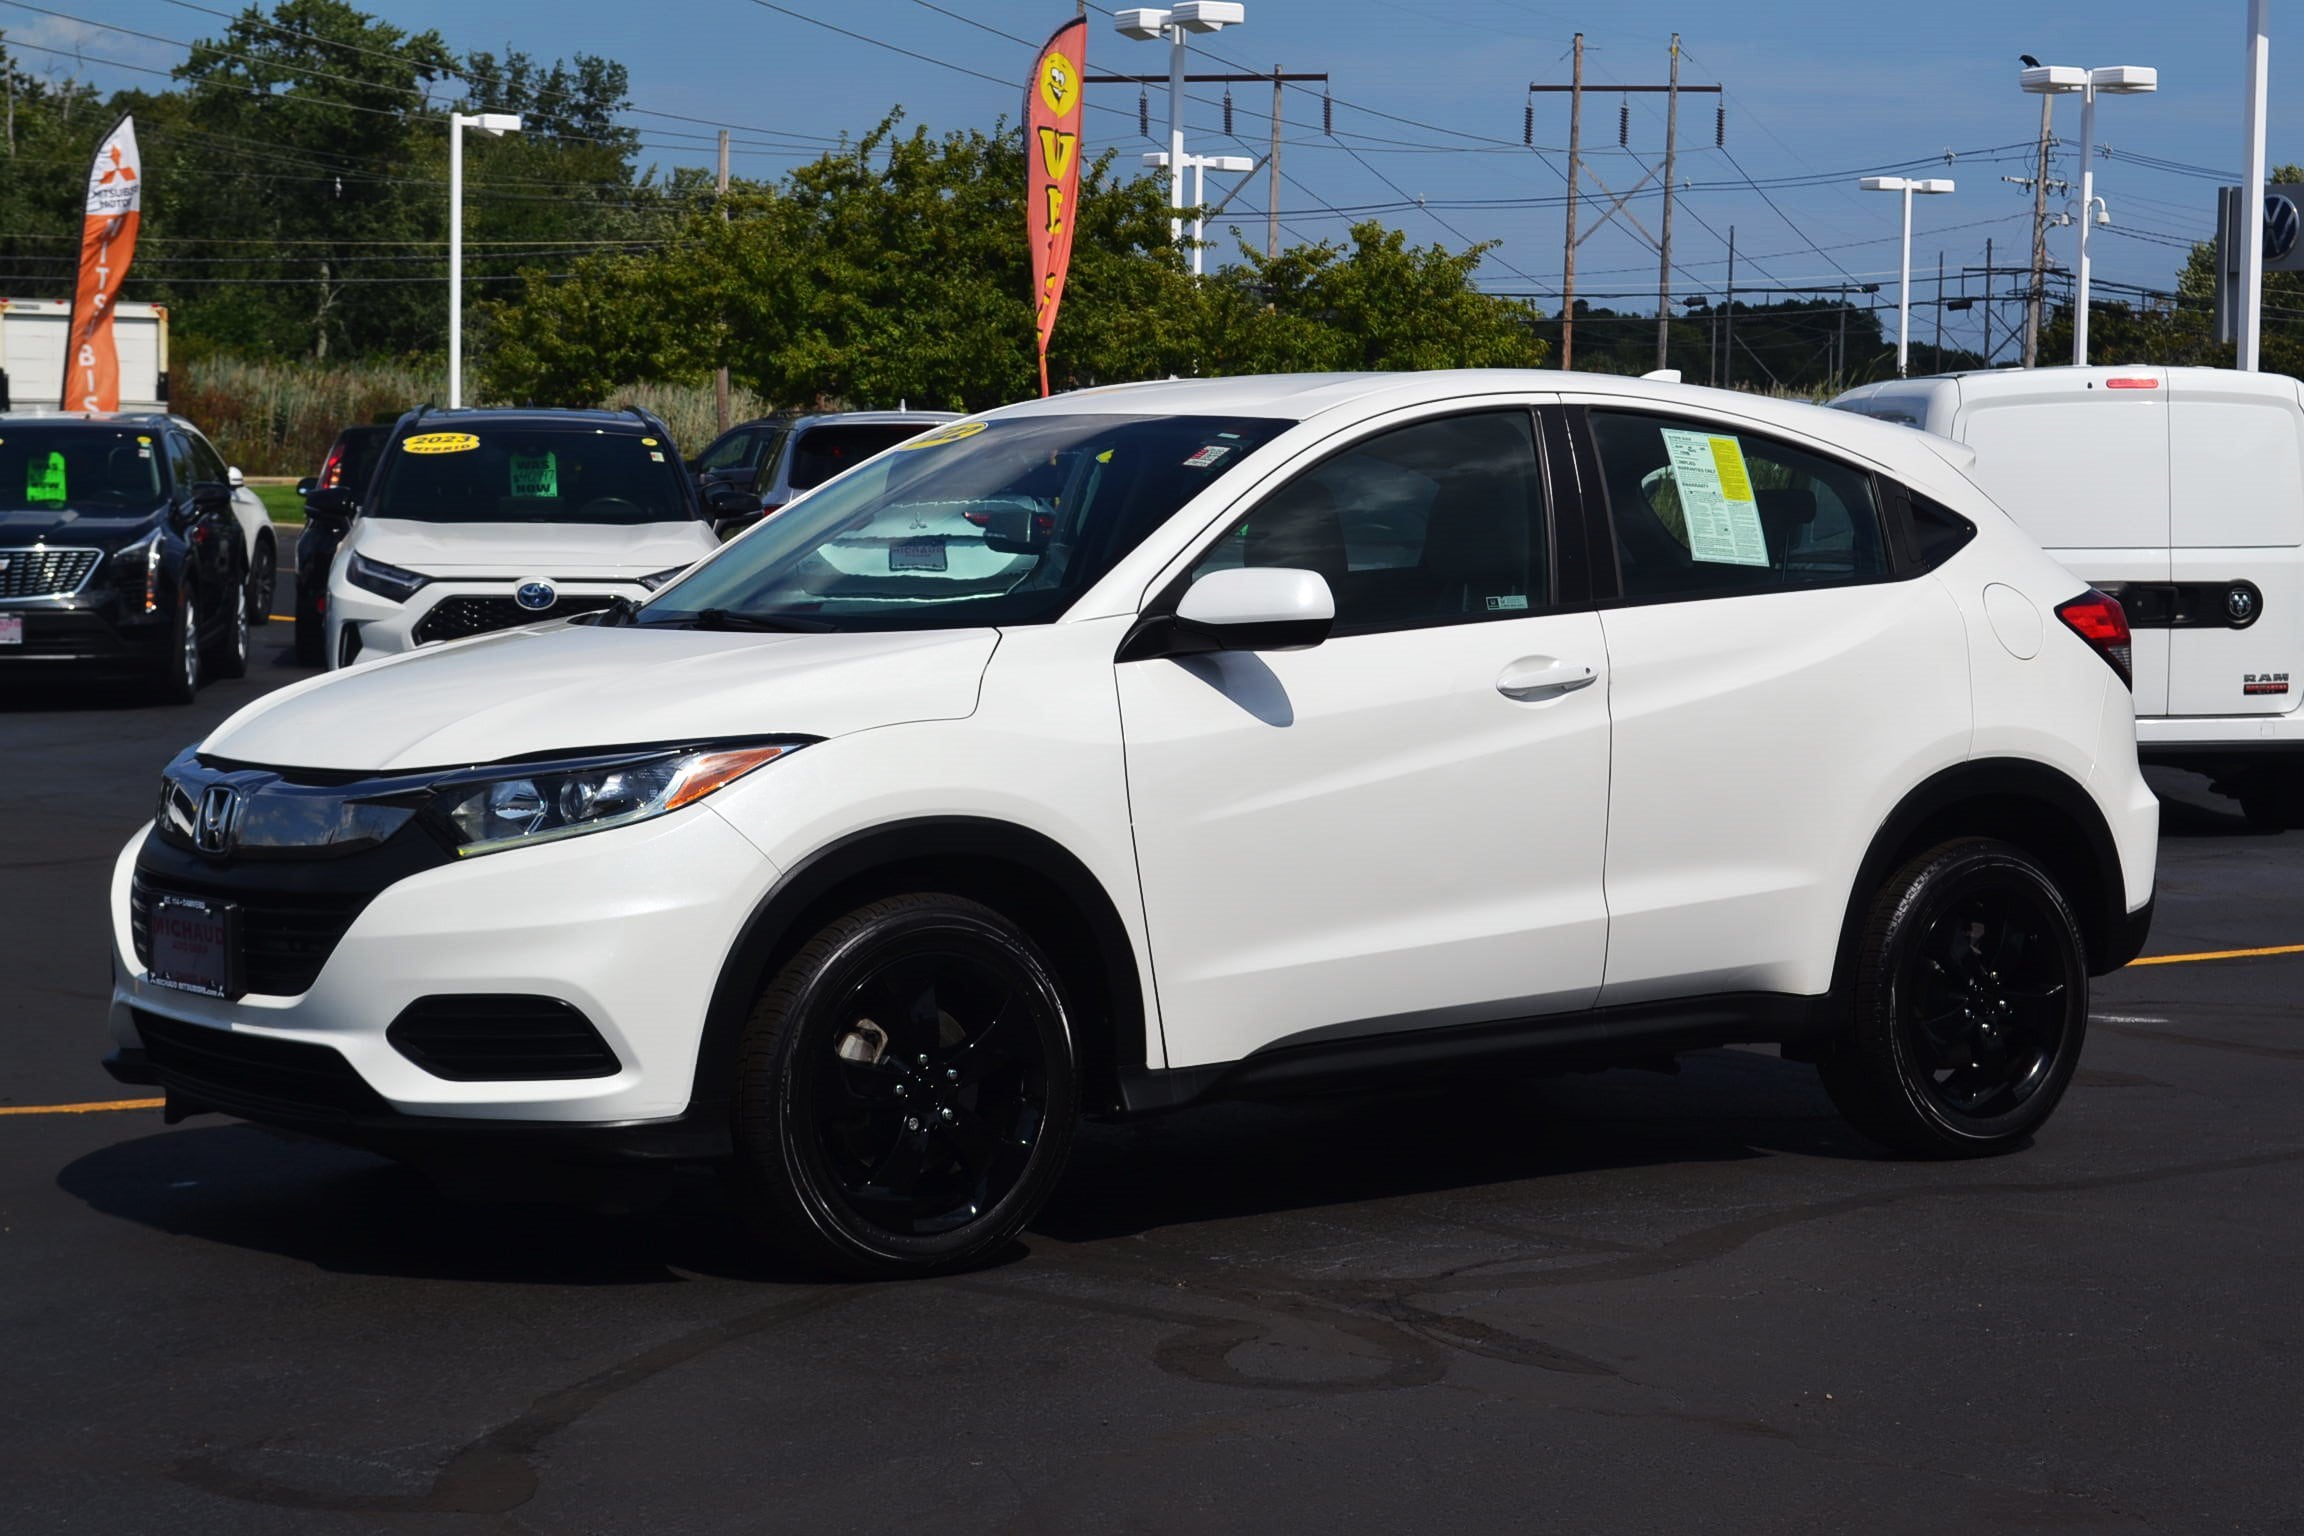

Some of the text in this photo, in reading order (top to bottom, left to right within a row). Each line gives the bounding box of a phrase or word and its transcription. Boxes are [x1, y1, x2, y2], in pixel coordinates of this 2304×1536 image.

[412, 435, 472, 444] 2023
[411, 443, 471, 452] HYBRID
[516, 483, 551, 494] NOW
[2243, 673, 2290, 683] RAM
[152, 916, 226, 945] MICHAUD
